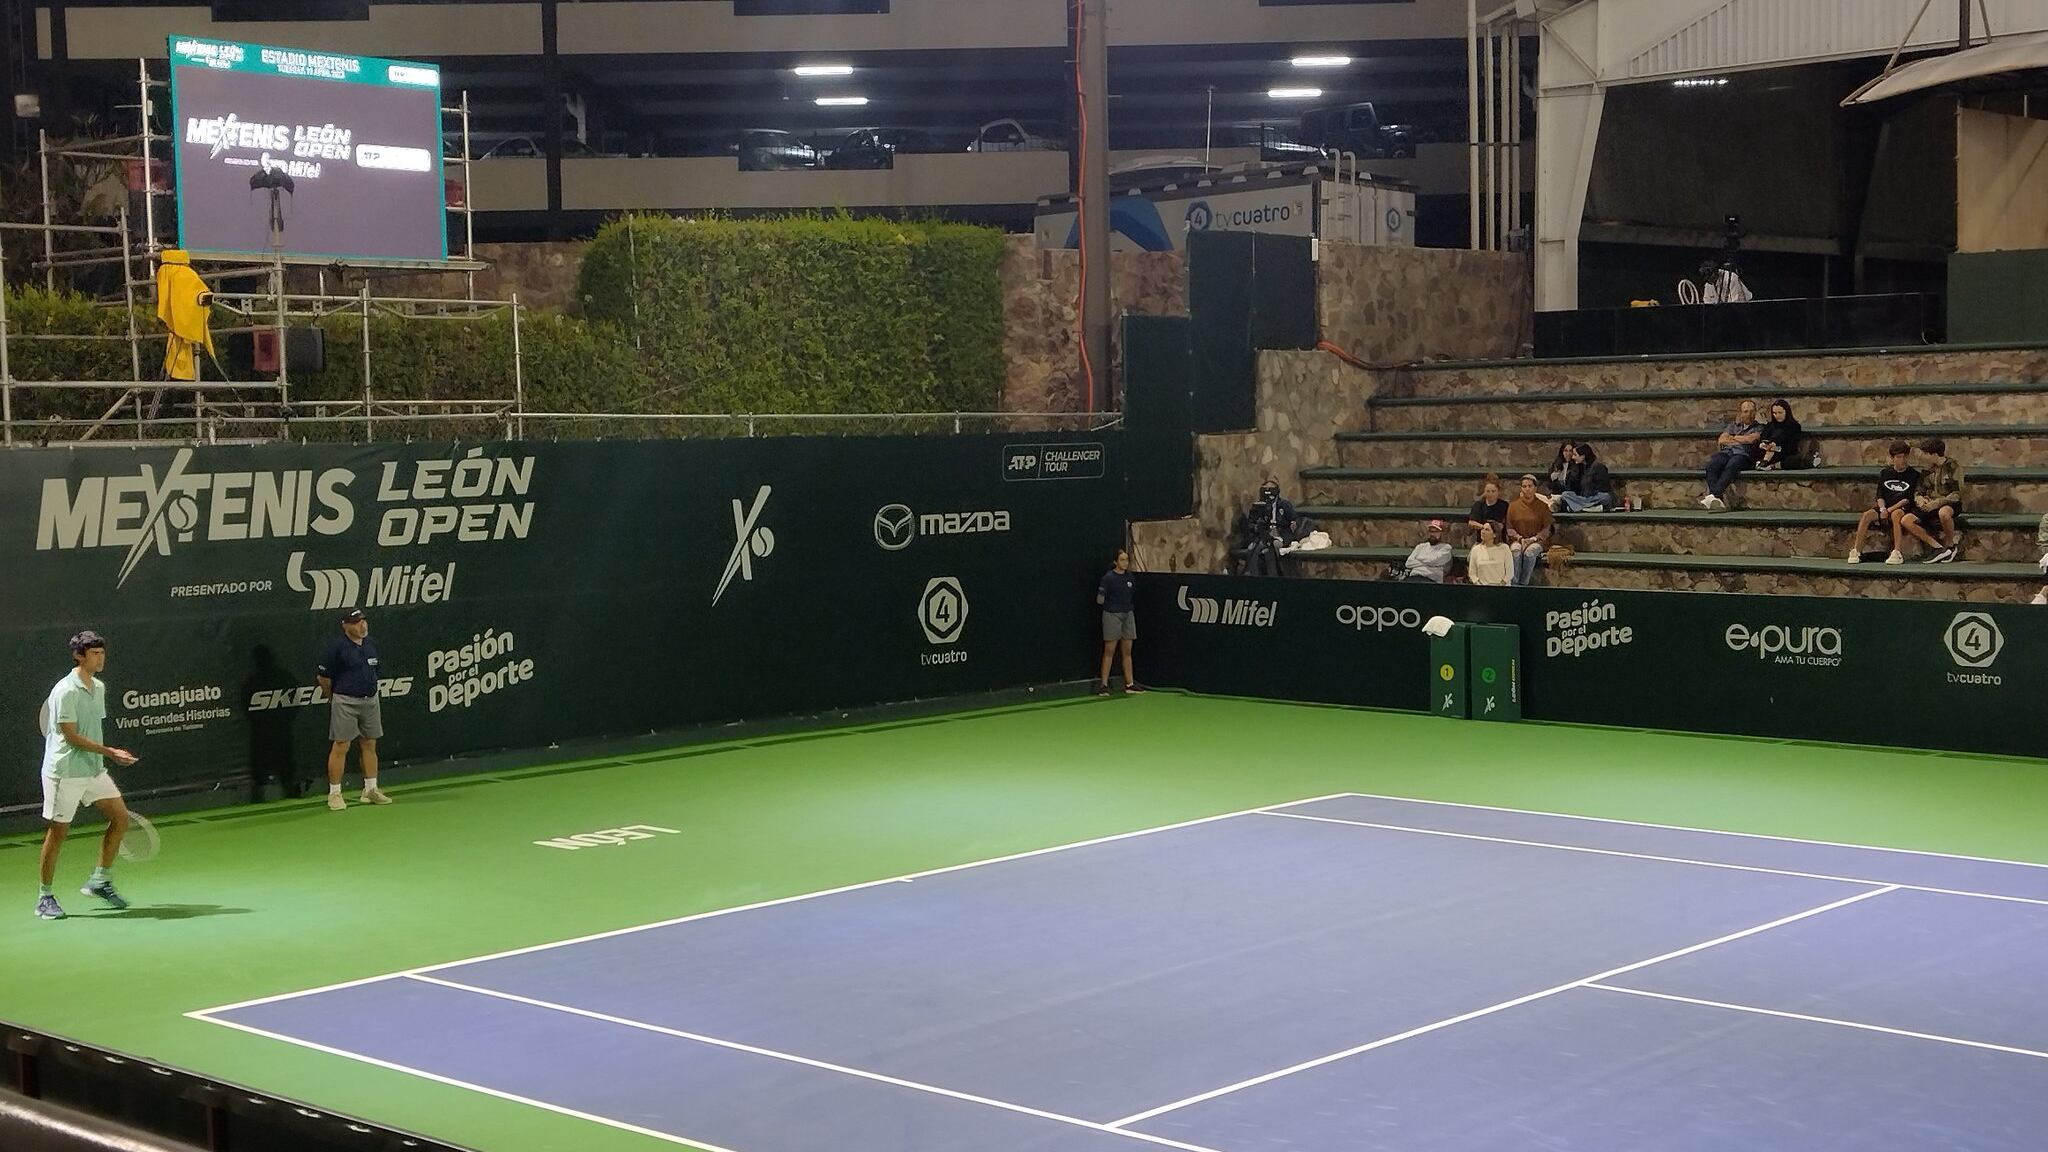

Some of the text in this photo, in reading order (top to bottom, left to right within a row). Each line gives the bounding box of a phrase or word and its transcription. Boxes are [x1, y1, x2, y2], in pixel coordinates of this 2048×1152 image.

[261, 49, 304, 66] ESTADIO
[186, 113, 351, 159] MEXTENIS LEÓN
[293, 141, 351, 160] OPEN
[1216, 205, 1290, 228] tvcuatro
[1008, 450, 1100, 470] ATP CHALLENGER
[1045, 462, 1068, 472] TOUR
[35, 446, 536, 588] MEXTENIS LEÓN
[377, 502, 535, 547] OPEN
[170, 579, 272, 598] PRESENTADO POR
[365, 562, 456, 609] Mifel
[936, 595, 950, 623] 4
[1221, 599, 1277, 627] Mifel
[1336, 604, 1421, 632] oppo
[1546, 598, 1616, 632] Pasión
[1546, 626, 1633, 658] Deporte
[1561, 624, 1587, 640] por el
[1964, 628, 1981, 651] 4
[428, 628, 513, 678] Pasión
[920, 648, 967, 666] tvcuatro
[1774, 655, 1840, 667] AMA TU CUERPO
[428, 658, 534, 713] Deporte
[448, 663, 479, 686] por el
[1946, 670, 2002, 686] tvcuatro
[122, 685, 222, 710] Guanajuato
[247, 677, 414, 711] SKECRS
[115, 707, 231, 729] Vive Grandes Historias
